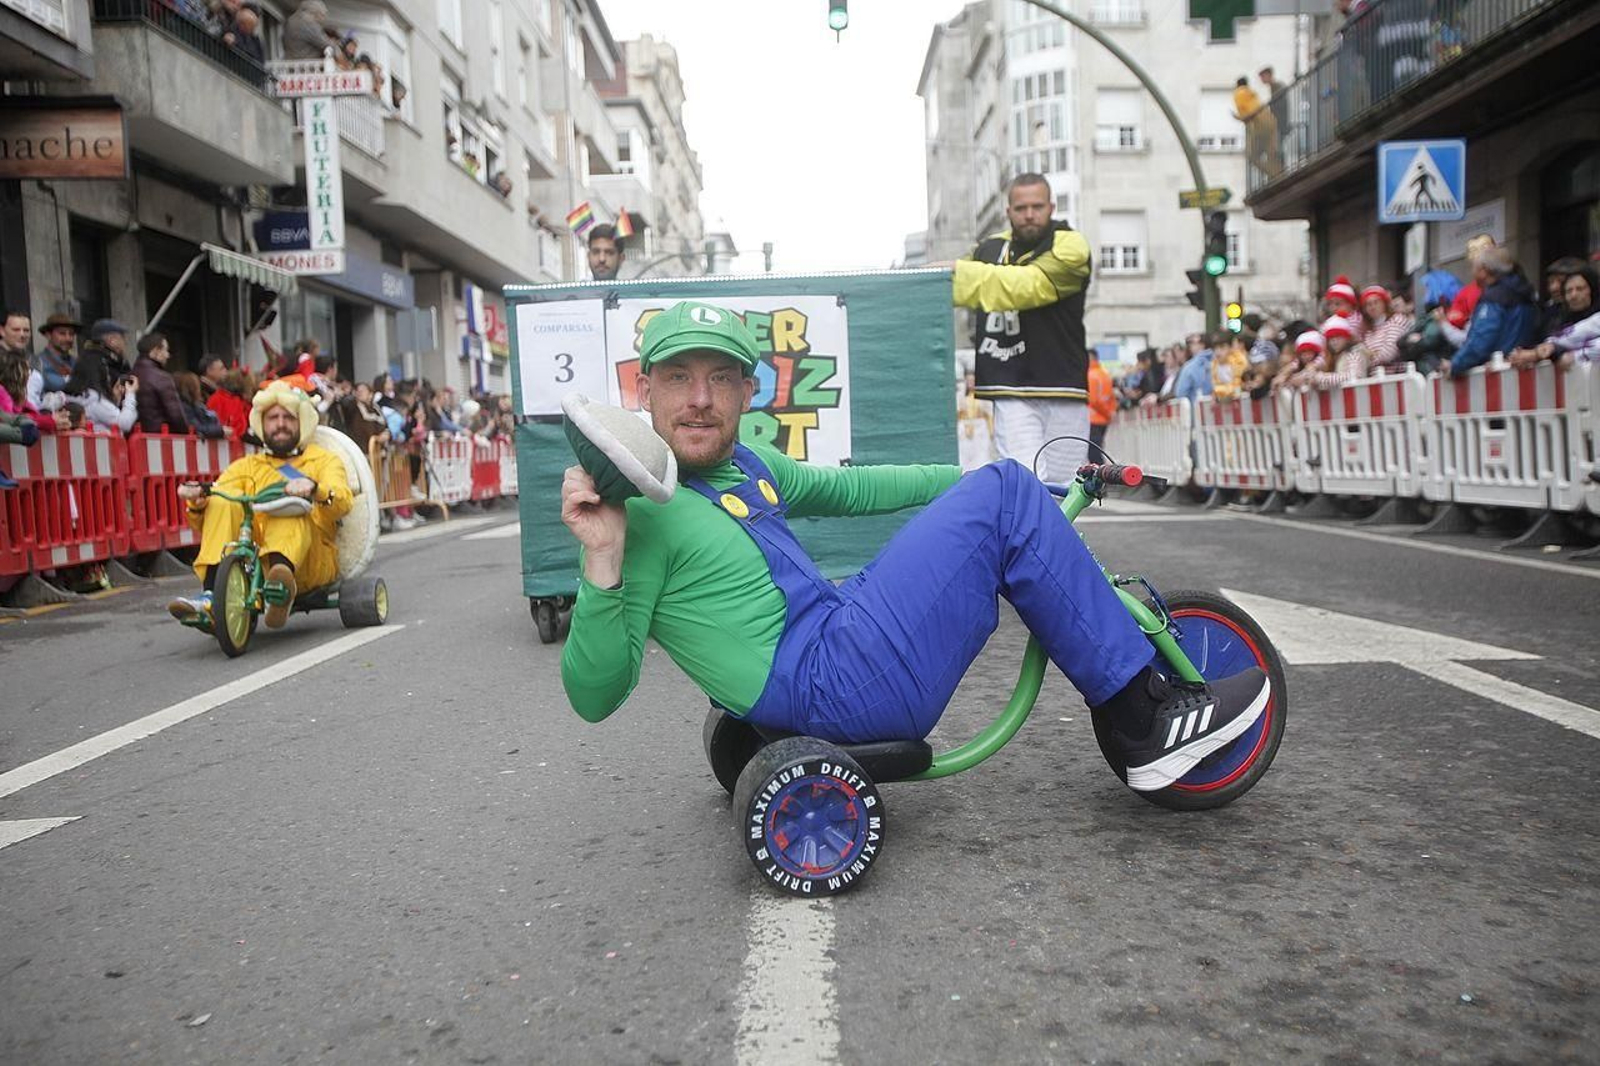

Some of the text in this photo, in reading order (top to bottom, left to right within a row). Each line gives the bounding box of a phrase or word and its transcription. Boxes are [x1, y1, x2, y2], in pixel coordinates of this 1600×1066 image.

[313, 101, 333, 243] FRUTERIA
[533, 323, 594, 335] COMPARSAS
[699, 308, 716, 324] L
[554, 353, 575, 383] 3
[751, 762, 867, 839] MAXIMUM DRIFT
[766, 816, 881, 893] MAXIMUM DRIFT
